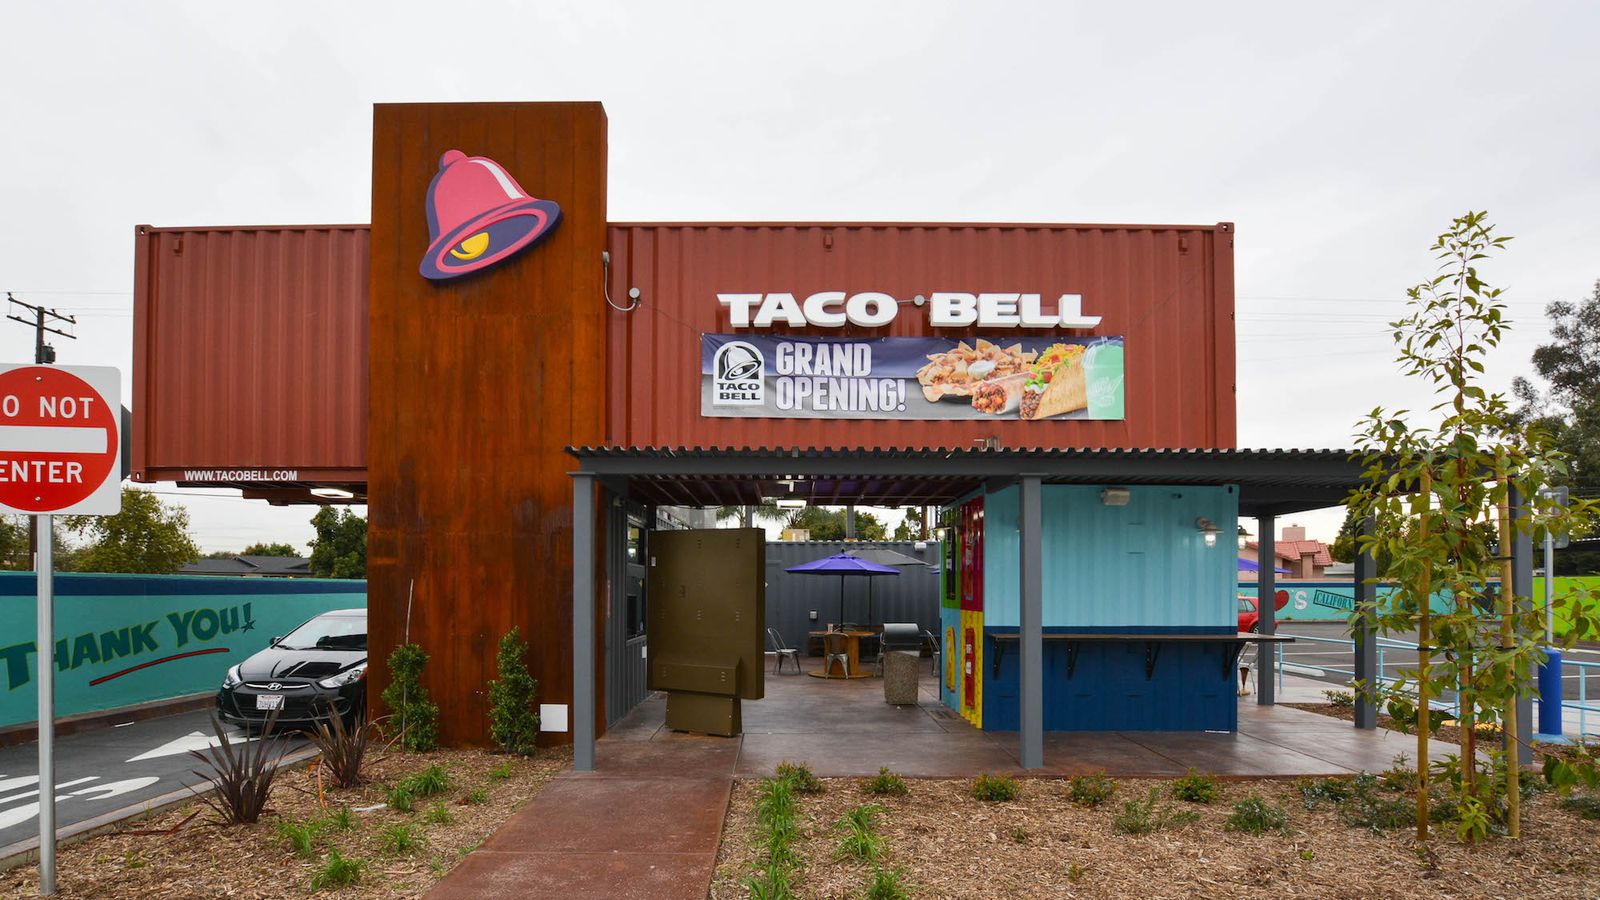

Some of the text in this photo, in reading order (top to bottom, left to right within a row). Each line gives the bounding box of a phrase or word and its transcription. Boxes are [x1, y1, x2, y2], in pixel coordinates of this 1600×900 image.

[716, 291, 1102, 328] TACO BELL
[776, 342, 871, 377] GRAND
[717, 382, 760, 391] TACO
[719, 392, 760, 401] BELL
[775, 376, 906, 412] OPENING!
[2, 394, 94, 419] O NOT
[0, 460, 83, 484] ENTER
[184, 470, 298, 481] WWW.TACOBELL.COM
[0, 620, 159, 690] THANK
